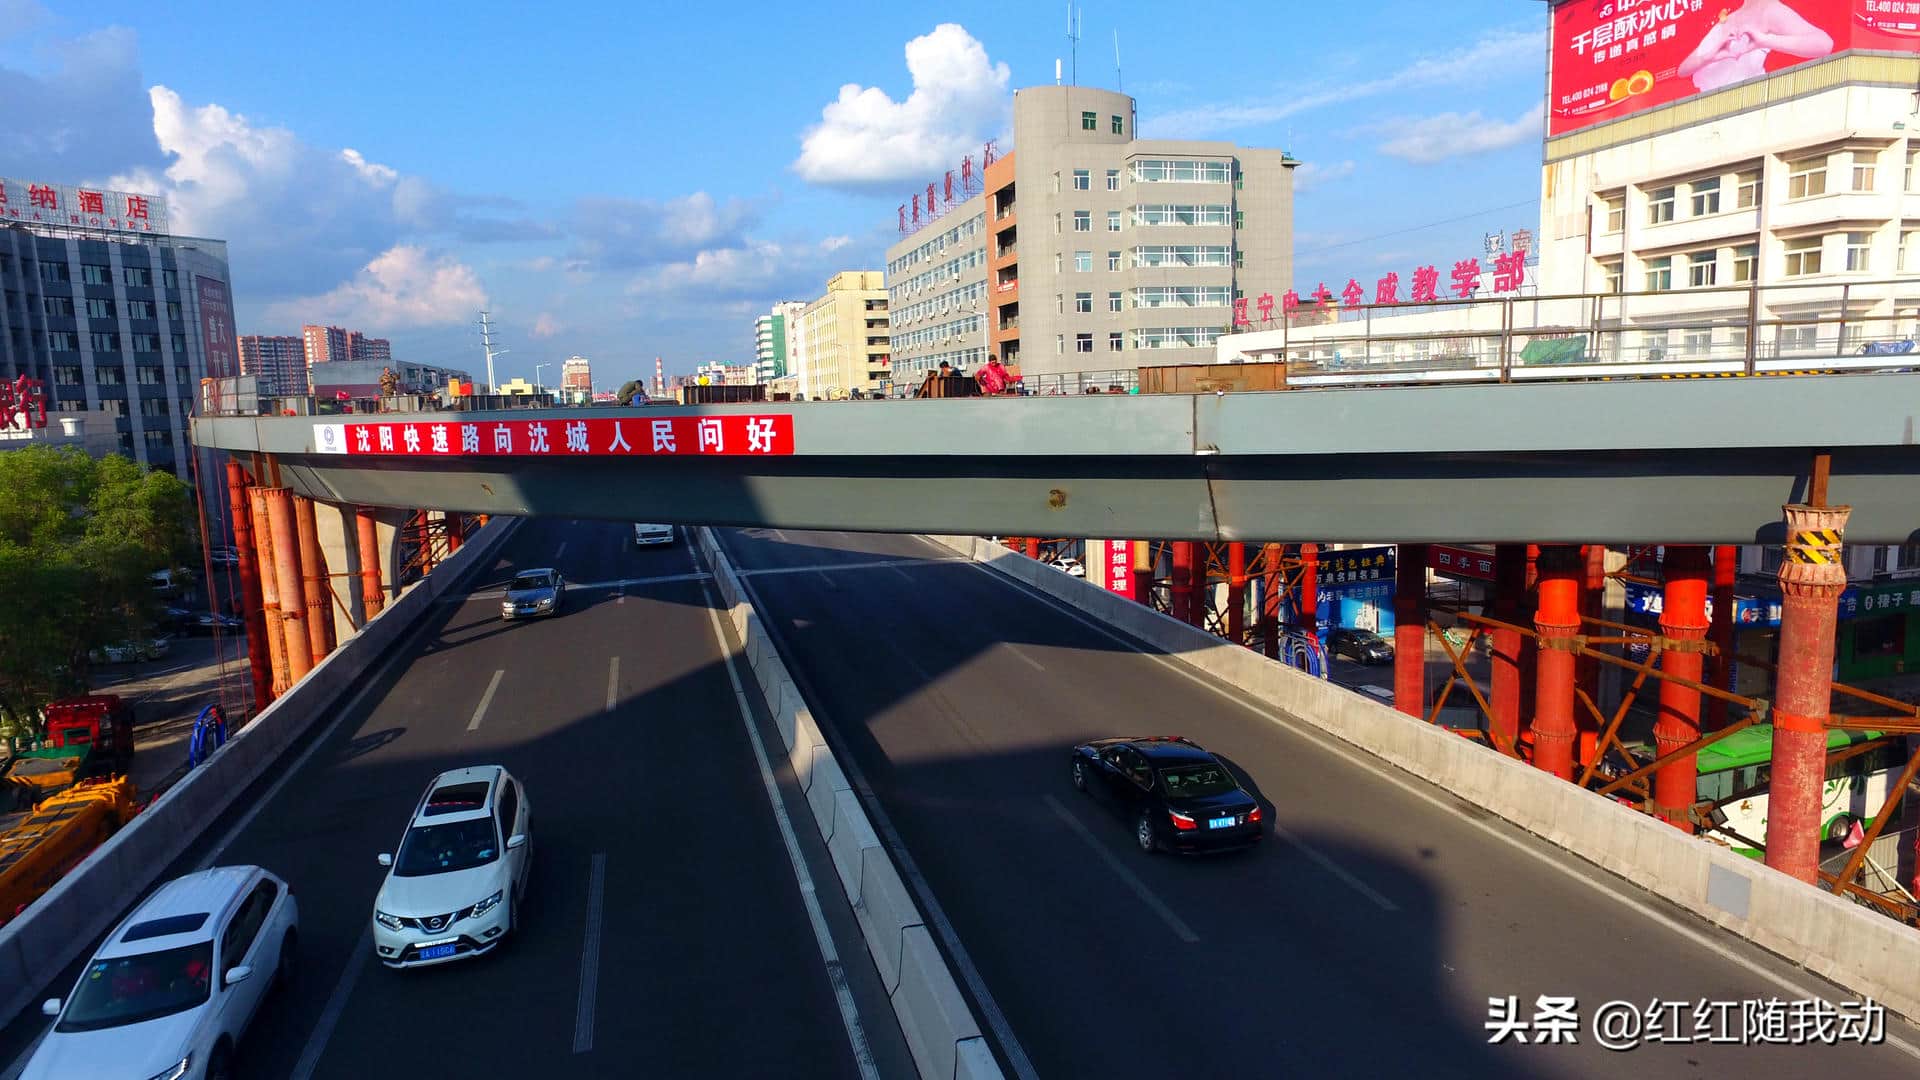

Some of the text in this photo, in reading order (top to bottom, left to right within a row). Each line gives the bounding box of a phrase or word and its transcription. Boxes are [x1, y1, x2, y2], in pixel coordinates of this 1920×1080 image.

[0, 181, 149, 220] 纳酒店
[70, 214, 152, 231] HOTEL
[355, 417, 777, 456] 沈阳快速路向沈城人民问好
[1112, 540, 1127, 591] 精细管理
